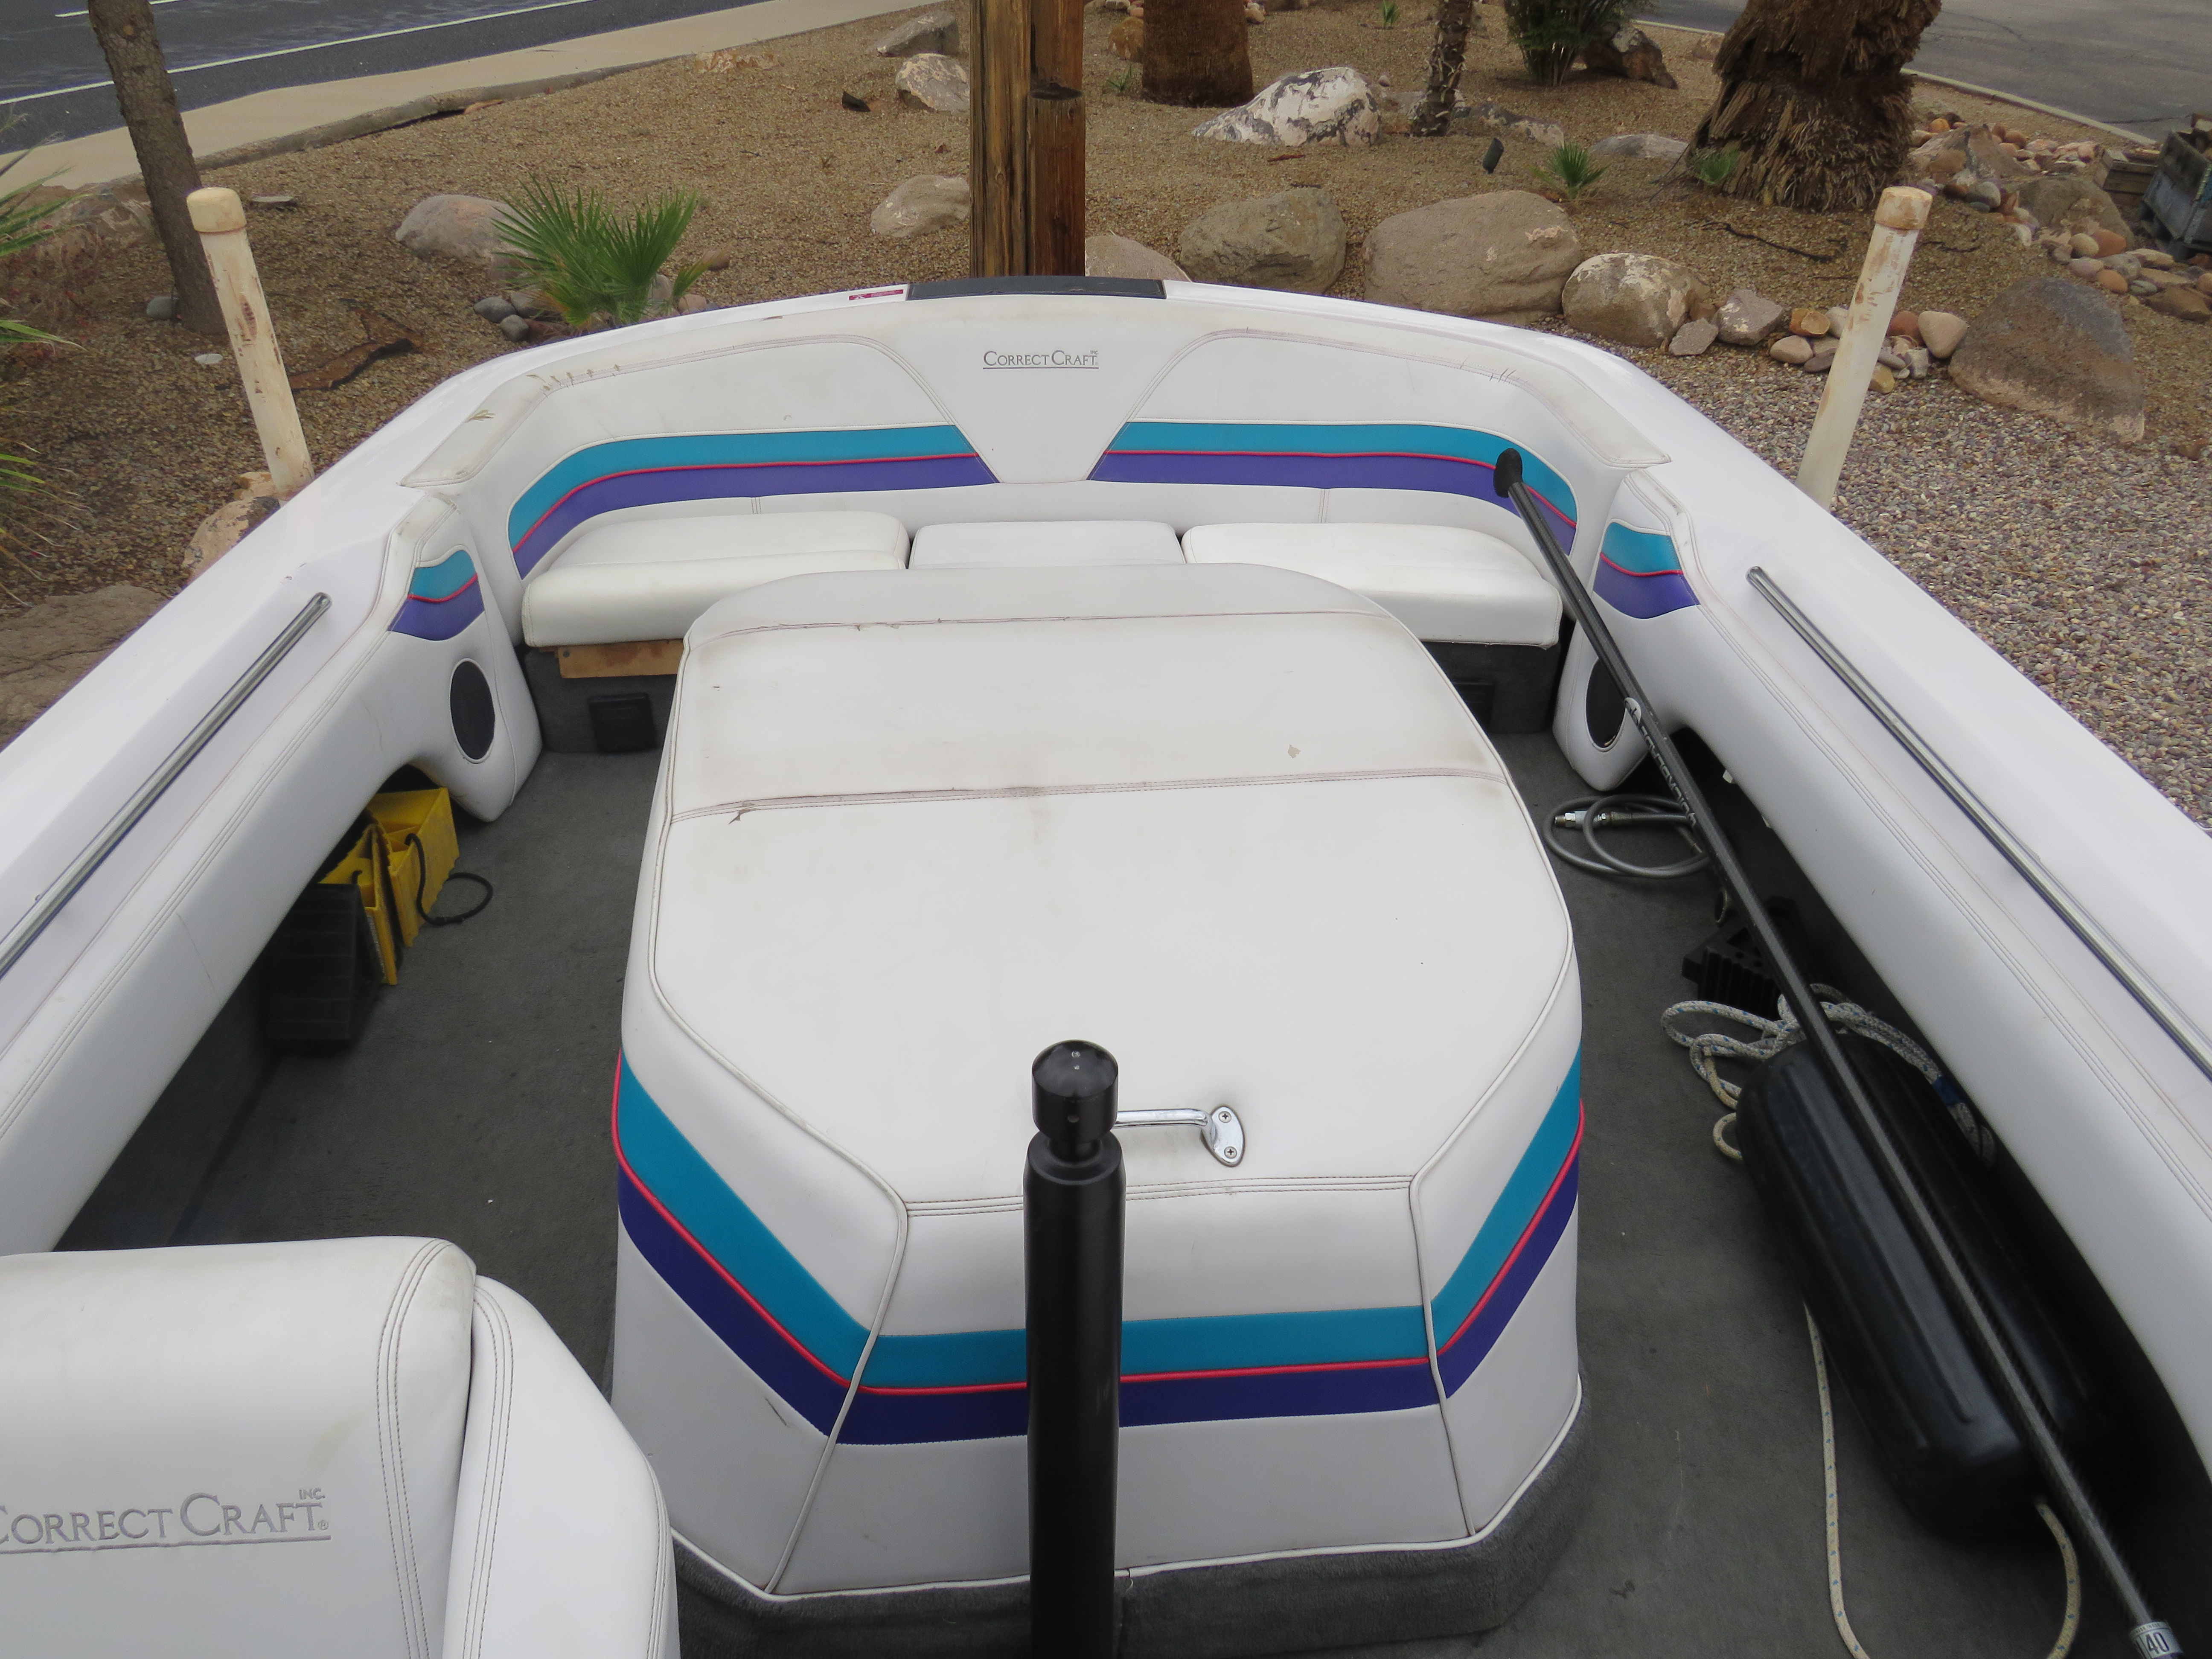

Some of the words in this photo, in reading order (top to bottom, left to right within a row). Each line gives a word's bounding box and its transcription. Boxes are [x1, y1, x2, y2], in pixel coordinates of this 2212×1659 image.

[0, 1505, 174, 1544] ORRECT
[180, 1492, 323, 1537] CRAFT
[2145, 1632, 2170, 1654] 40
